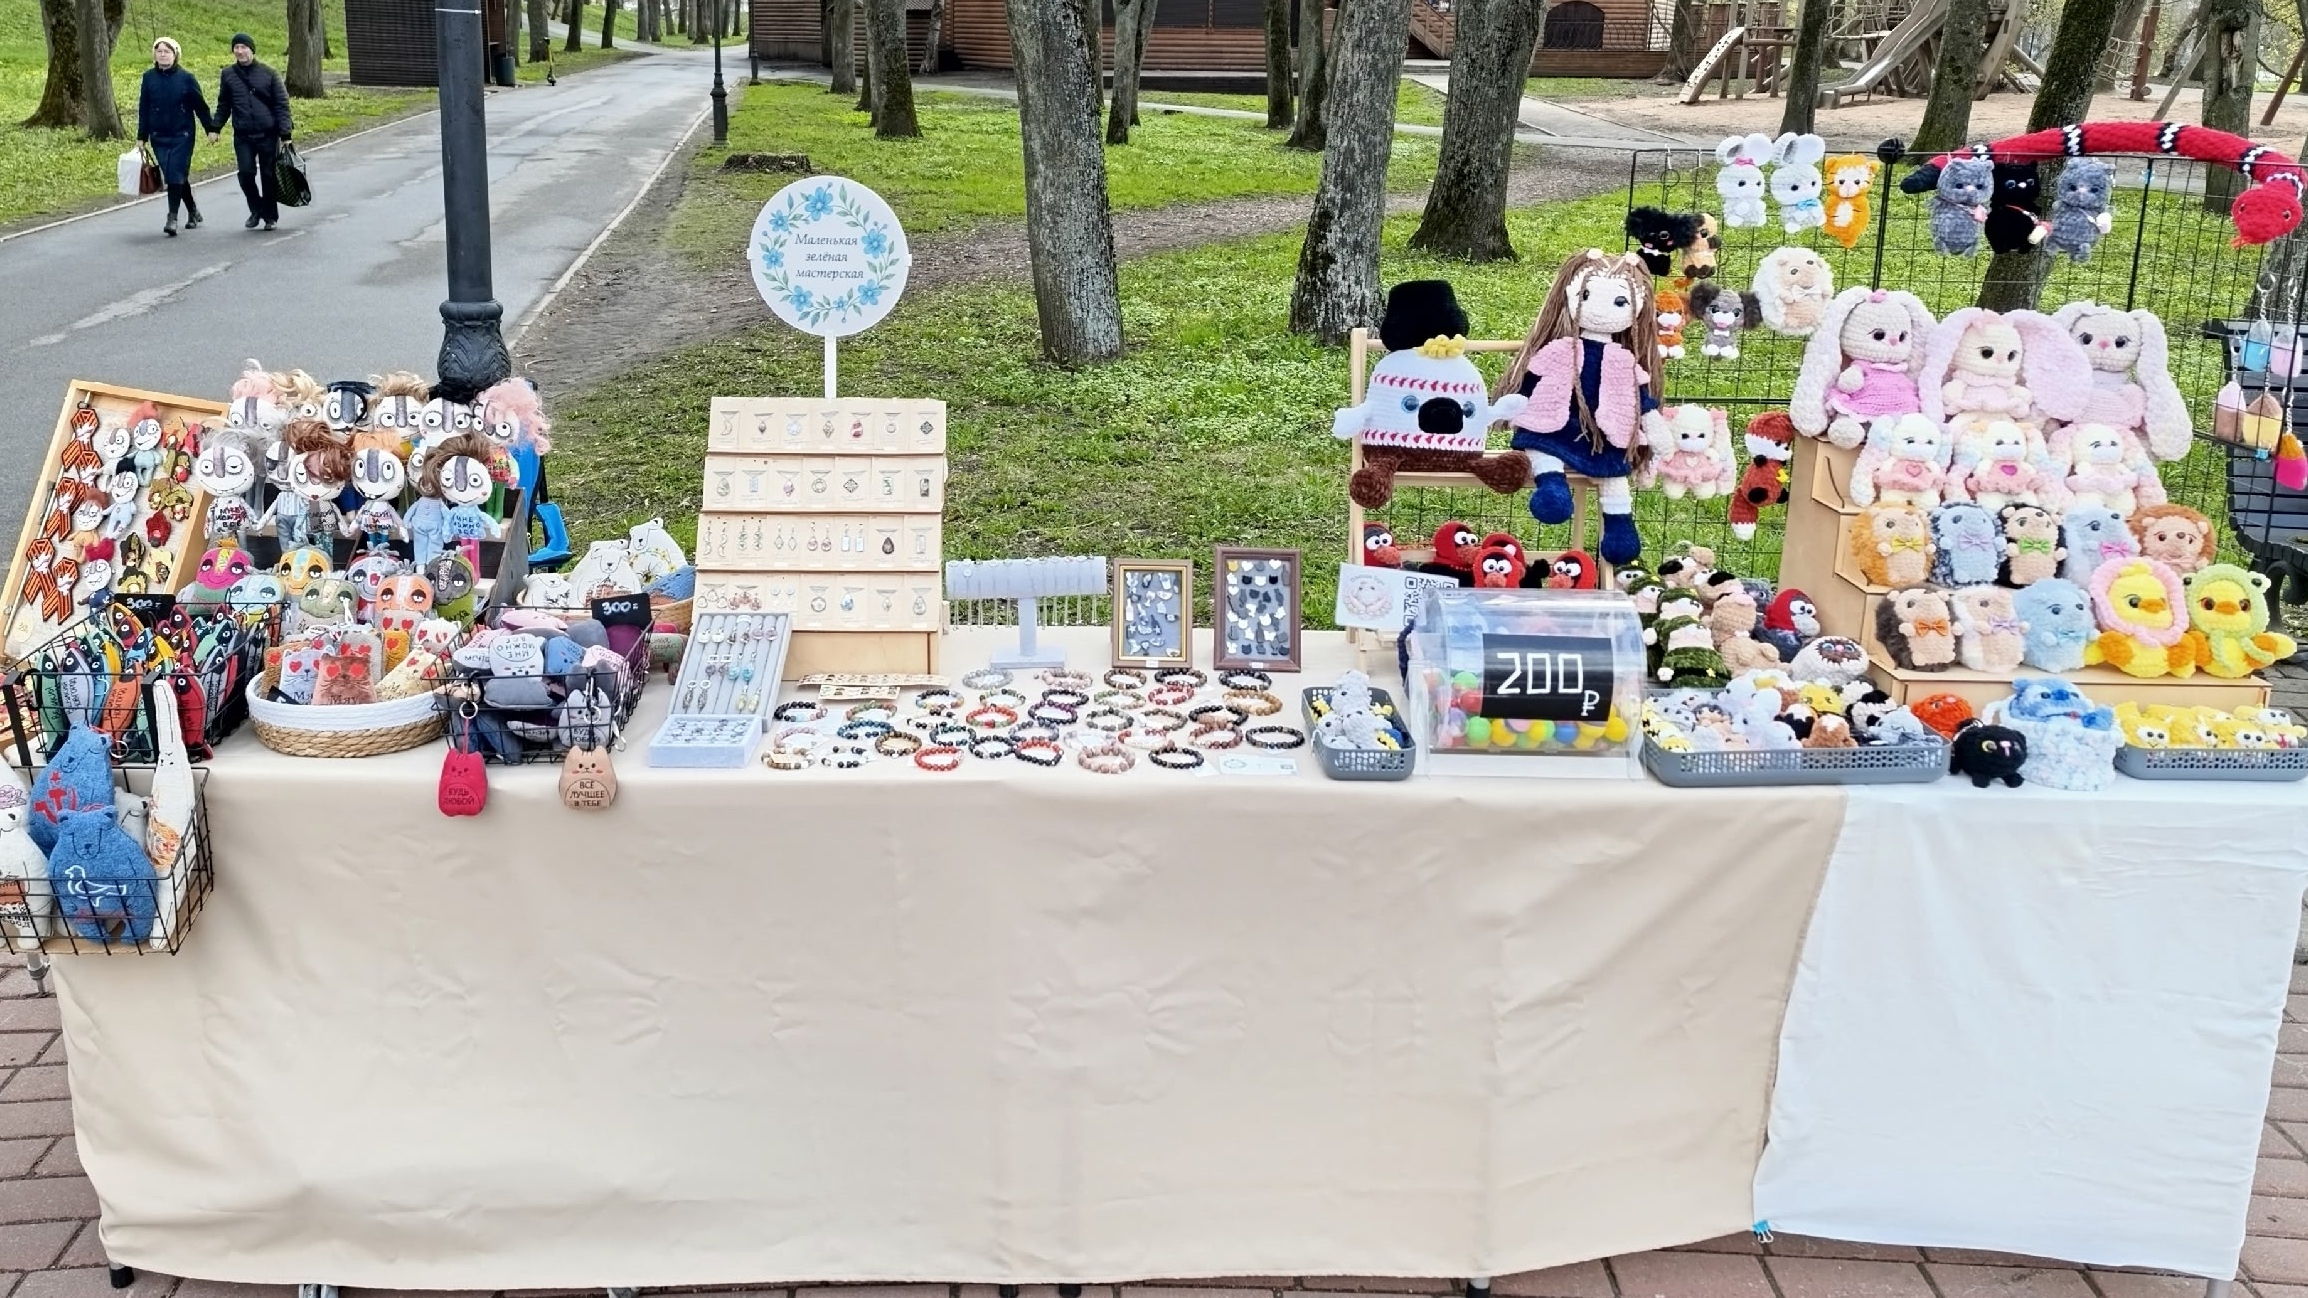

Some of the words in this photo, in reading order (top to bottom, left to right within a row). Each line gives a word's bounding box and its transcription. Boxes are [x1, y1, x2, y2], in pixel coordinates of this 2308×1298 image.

[795, 233, 859, 247] Маленькая
[805, 252, 848, 263] зелёная
[795, 269, 865, 281] мастерская
[449, 787, 470, 797] БУДЬ
[569, 789, 606, 799] ЛУЧШЕЕ
[582, 799, 602, 807] ТЕБЕ
